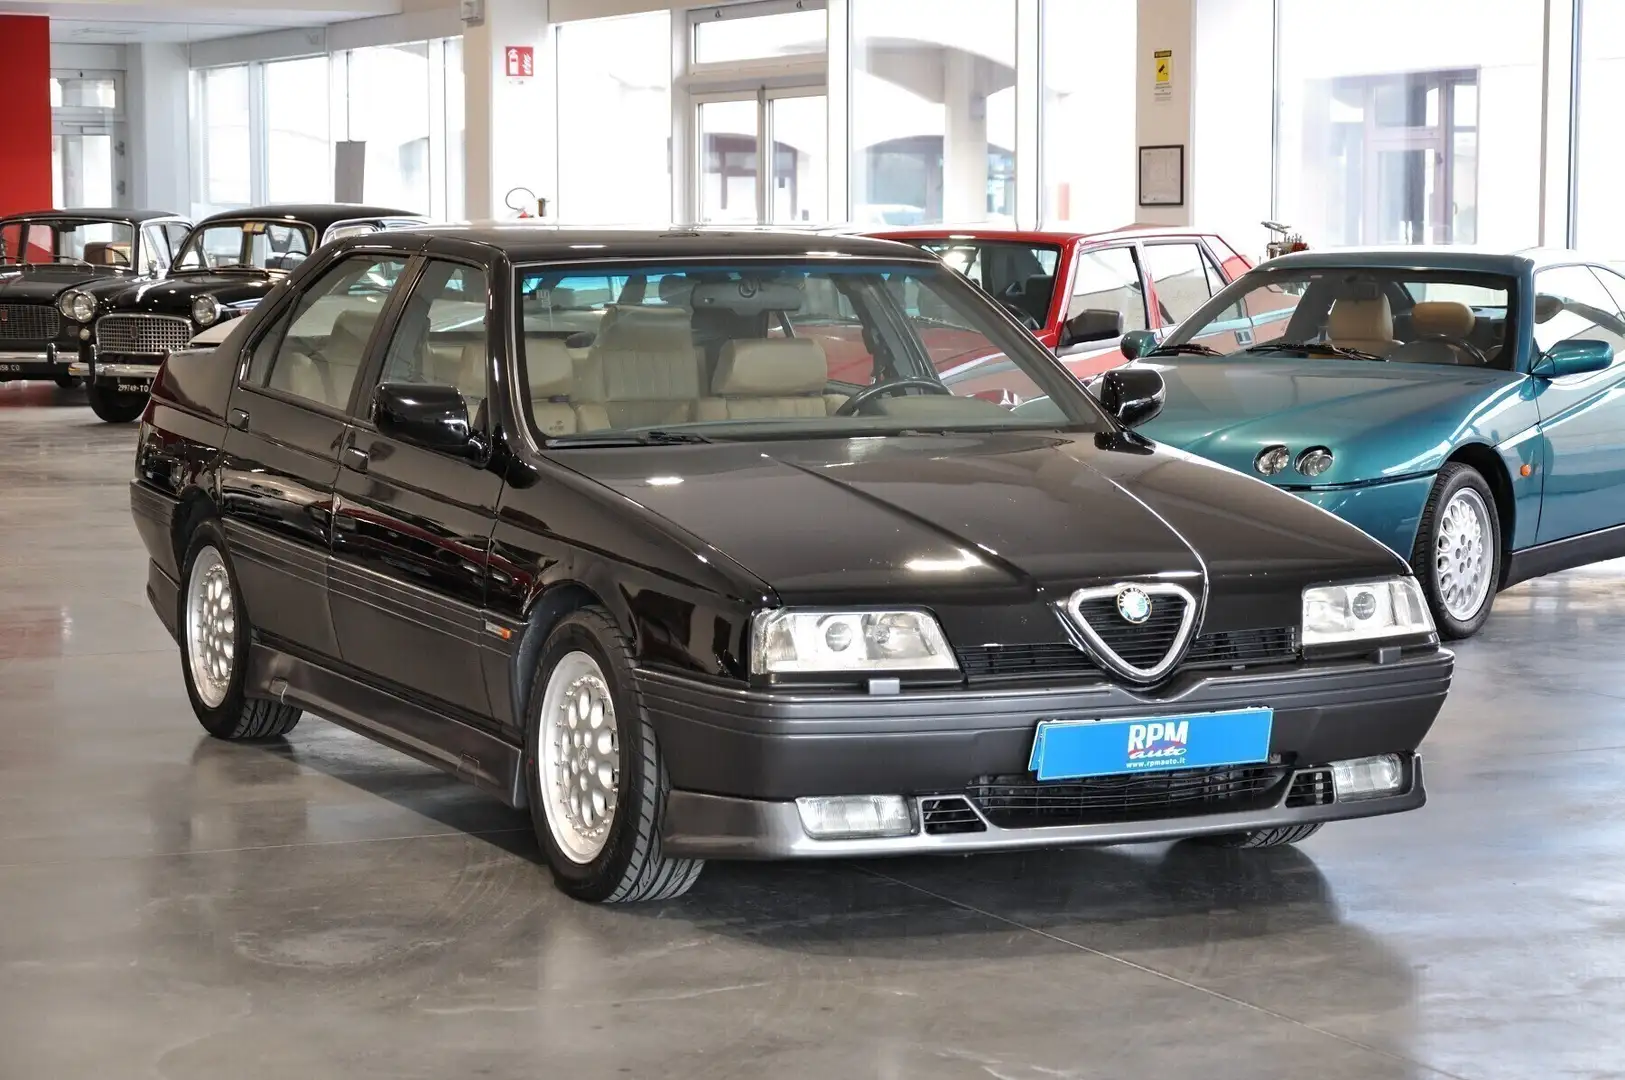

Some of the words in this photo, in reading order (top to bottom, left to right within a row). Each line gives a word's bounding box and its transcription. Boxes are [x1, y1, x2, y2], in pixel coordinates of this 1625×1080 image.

[1128, 720, 1189, 754] RPM
[1129, 746, 1187, 760] auto
[1126, 757, 1187, 769] www.rpmauto.it
